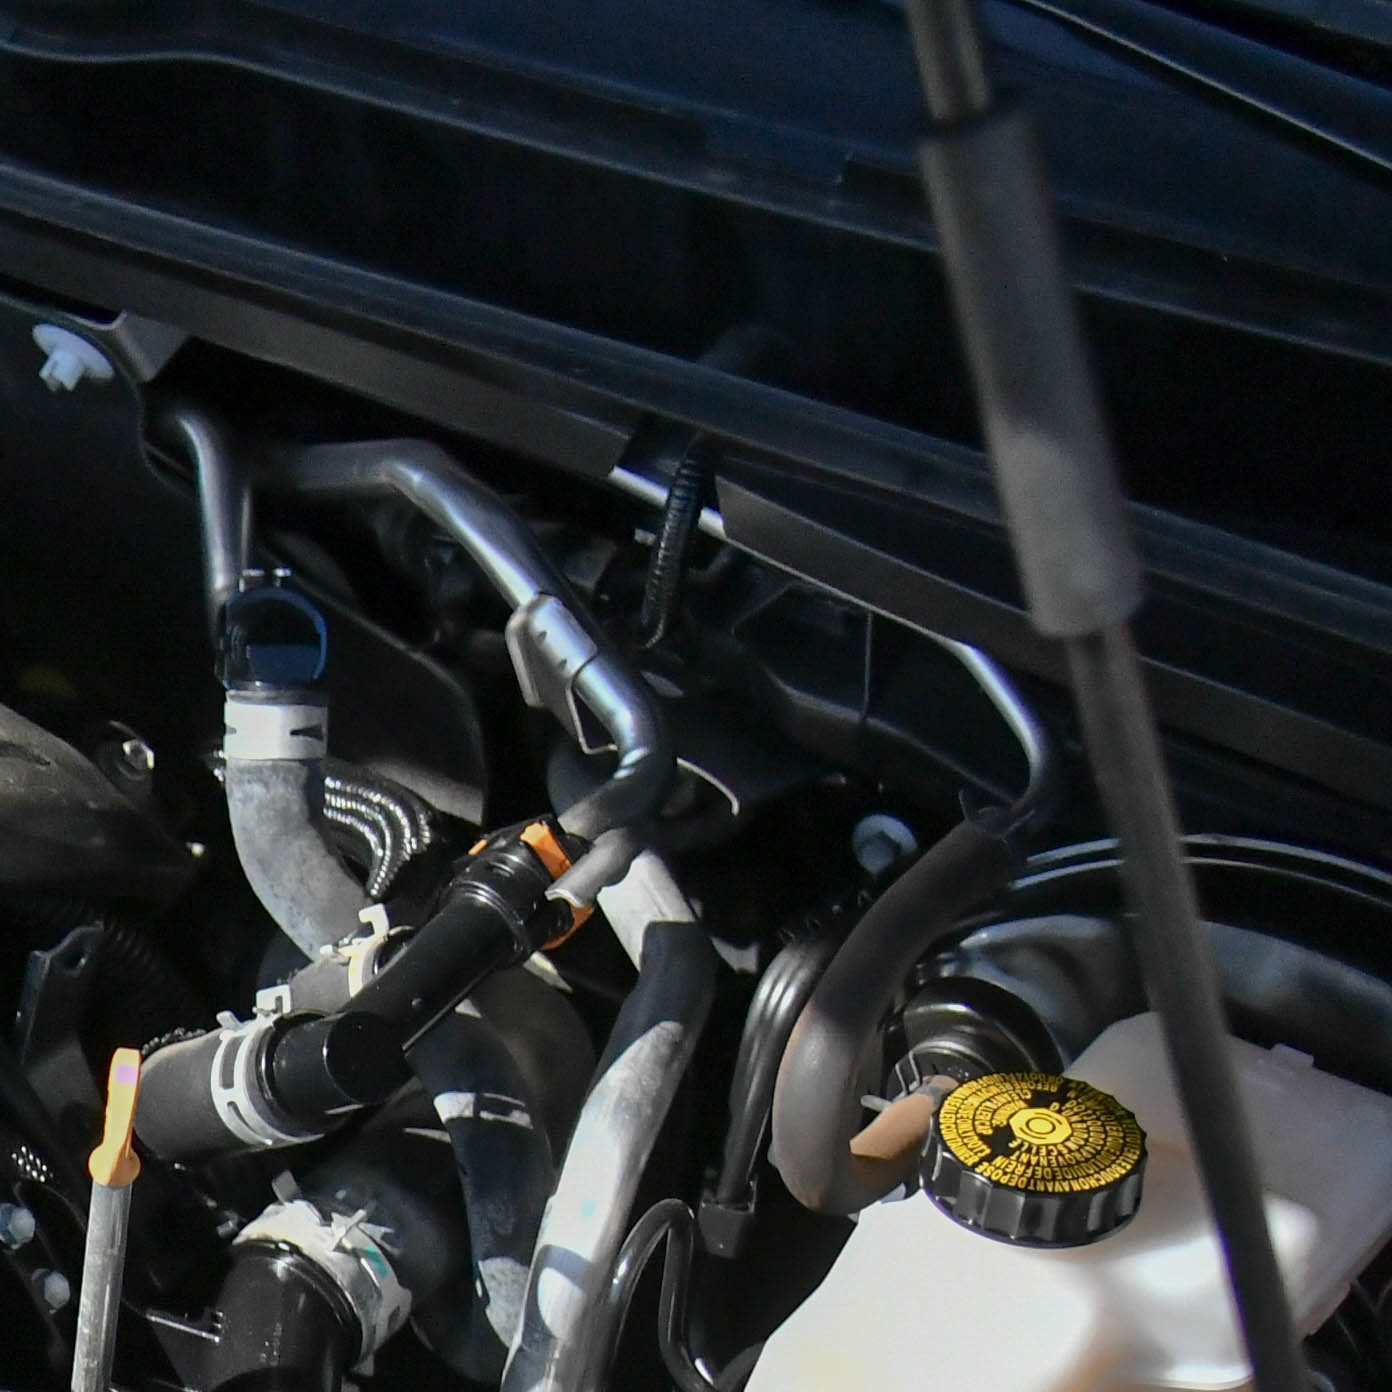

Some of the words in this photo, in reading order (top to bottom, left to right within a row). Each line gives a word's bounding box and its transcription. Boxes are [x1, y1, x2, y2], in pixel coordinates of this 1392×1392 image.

[1005, 1137, 1069, 1155] SCELLE
[1007, 1146, 1092, 1166] PROVENANT
[972, 1161, 1028, 1188] DEPOSE
[989, 1154, 1033, 1177] FREIN
[1026, 1178, 1073, 1191] AVANT
